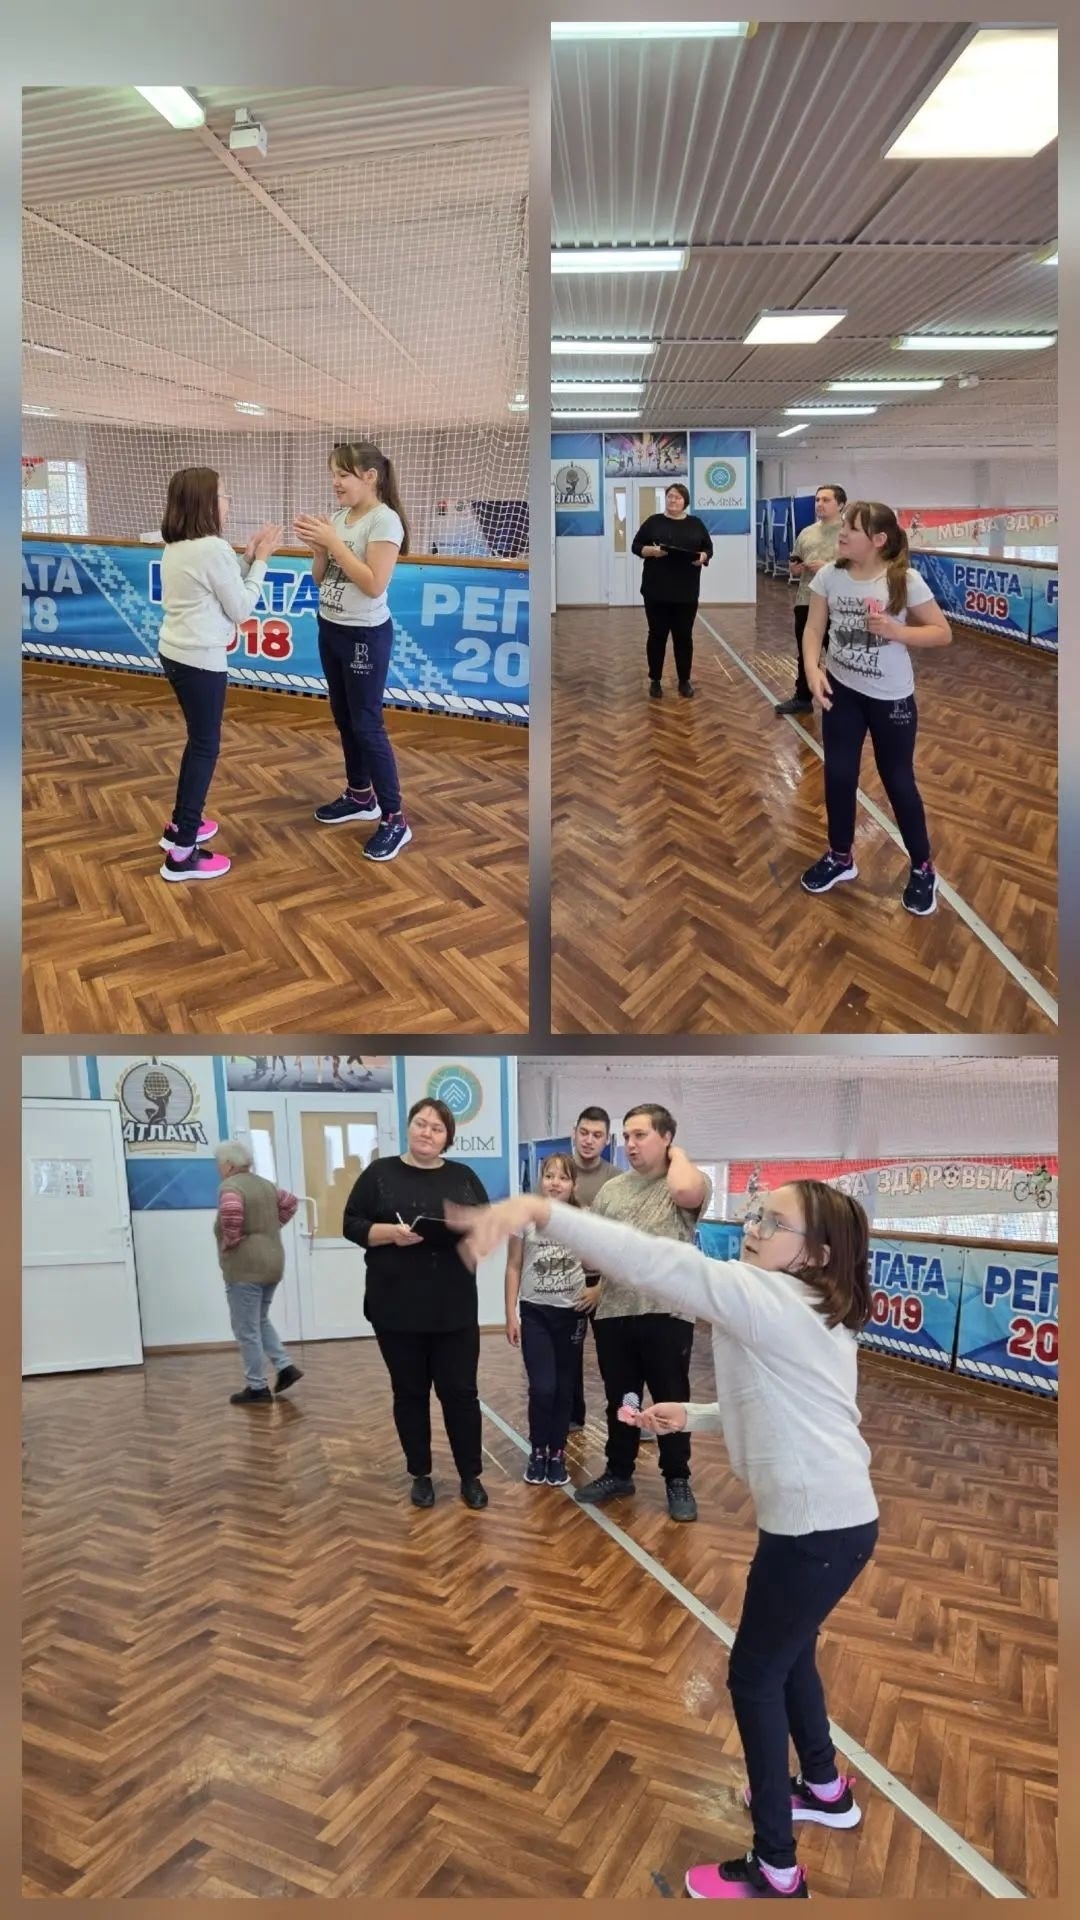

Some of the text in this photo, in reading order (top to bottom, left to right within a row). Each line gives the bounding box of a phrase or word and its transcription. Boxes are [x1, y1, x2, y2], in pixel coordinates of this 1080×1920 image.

[953, 563, 1024, 600] РЕГАТА
[421, 582, 529, 634] РЕГ
[964, 590, 1010, 621] 2019
[226, 616, 293, 661] 18
[452, 637, 529, 688] 20
[122, 1120, 208, 1145] АТЛАНТ
[876, 1163, 1014, 1197] ЗДОРОВЫЙ
[871, 1289, 924, 1333] 019
[983, 1264, 1058, 1316] РЕГ
[1007, 1316, 1058, 1366] 20
